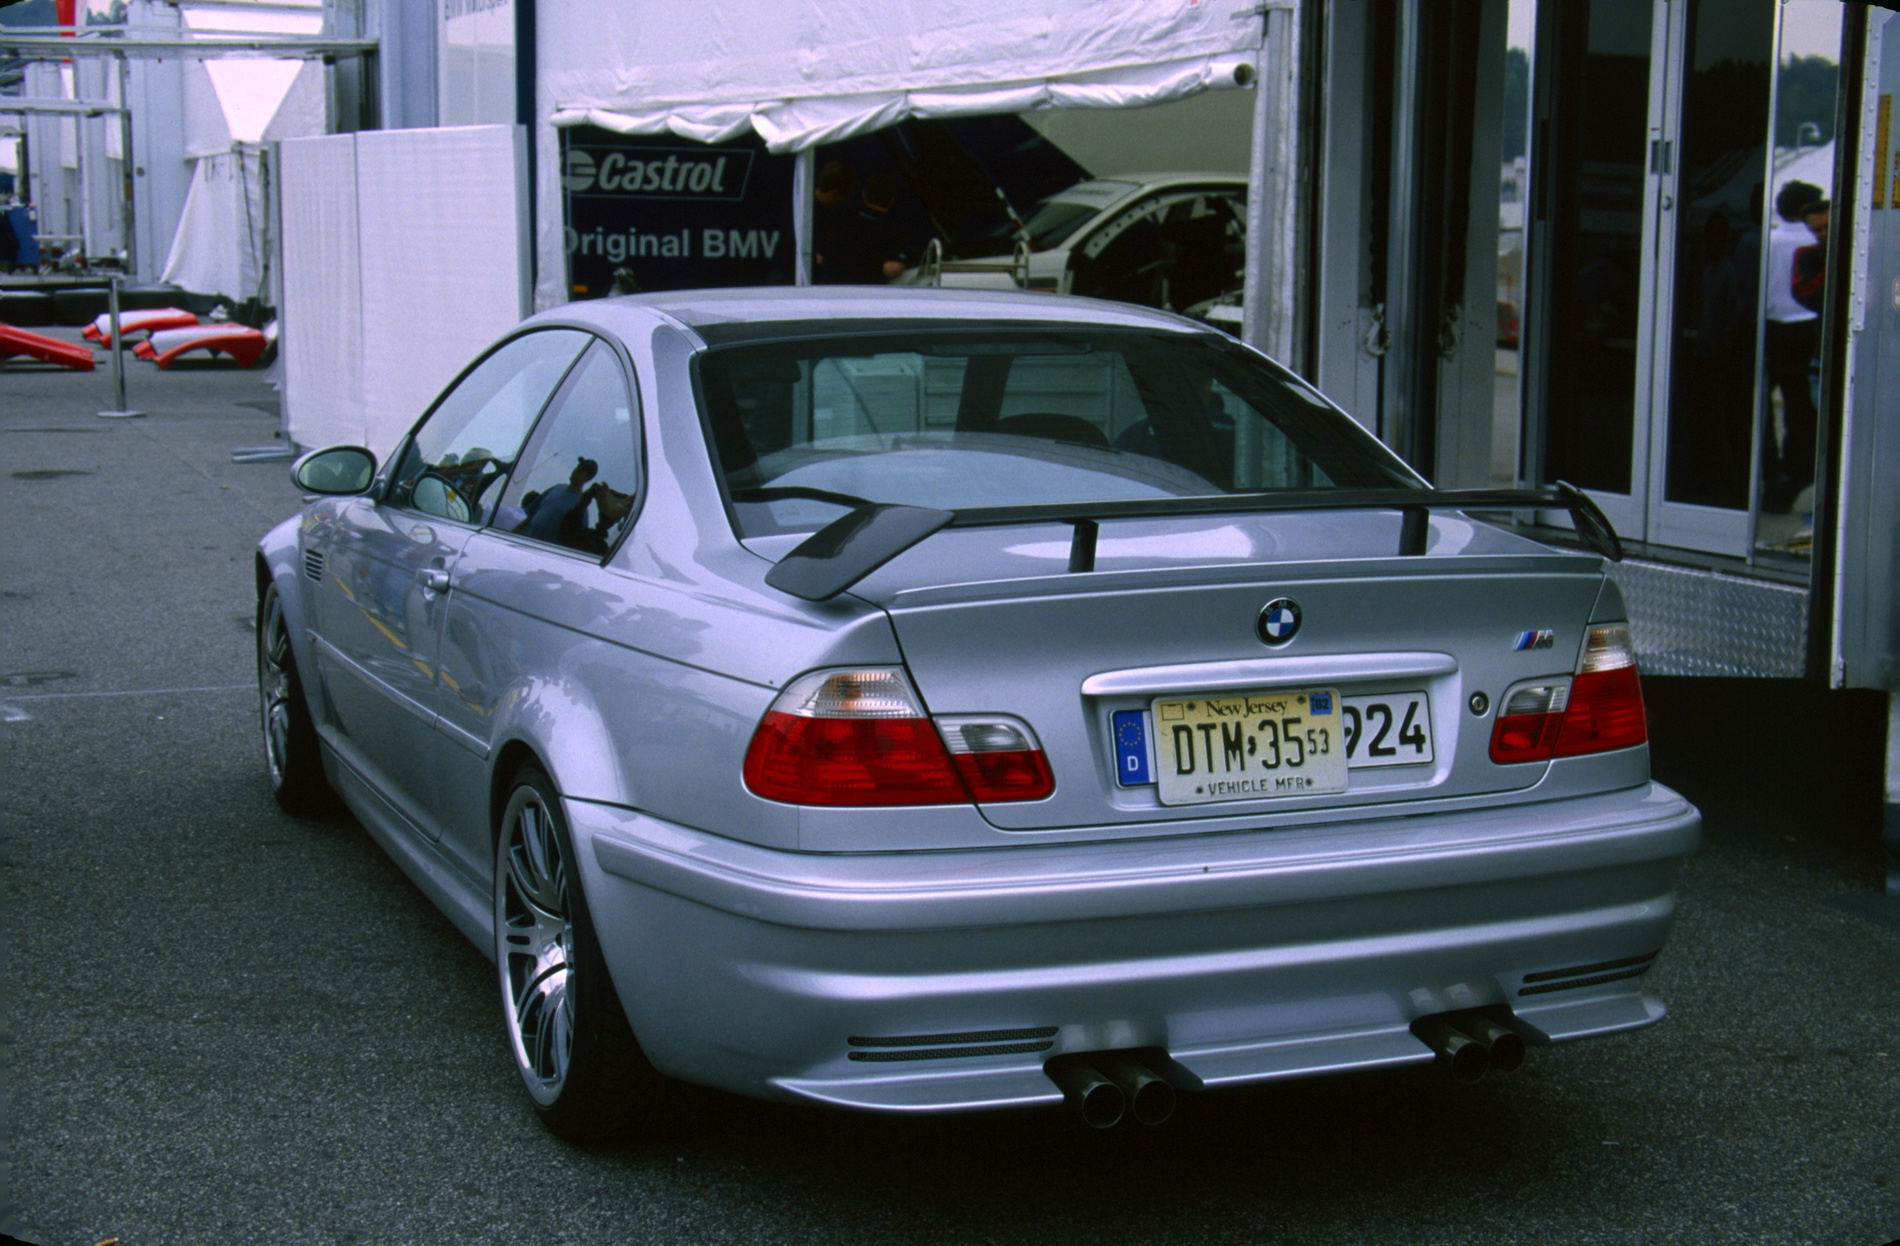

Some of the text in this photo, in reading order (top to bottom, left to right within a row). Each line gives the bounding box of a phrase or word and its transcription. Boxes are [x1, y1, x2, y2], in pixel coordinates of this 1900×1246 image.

[599, 153, 727, 192] Castrol
[564, 226, 690, 263] Original
[1264, 600, 1300, 615] BMW
[1205, 697, 1288, 717] New Jersey
[1307, 728, 1329, 754] 53
[1127, 756, 1139, 771] D
[1208, 776, 1306, 795] VEHICLE MFR
